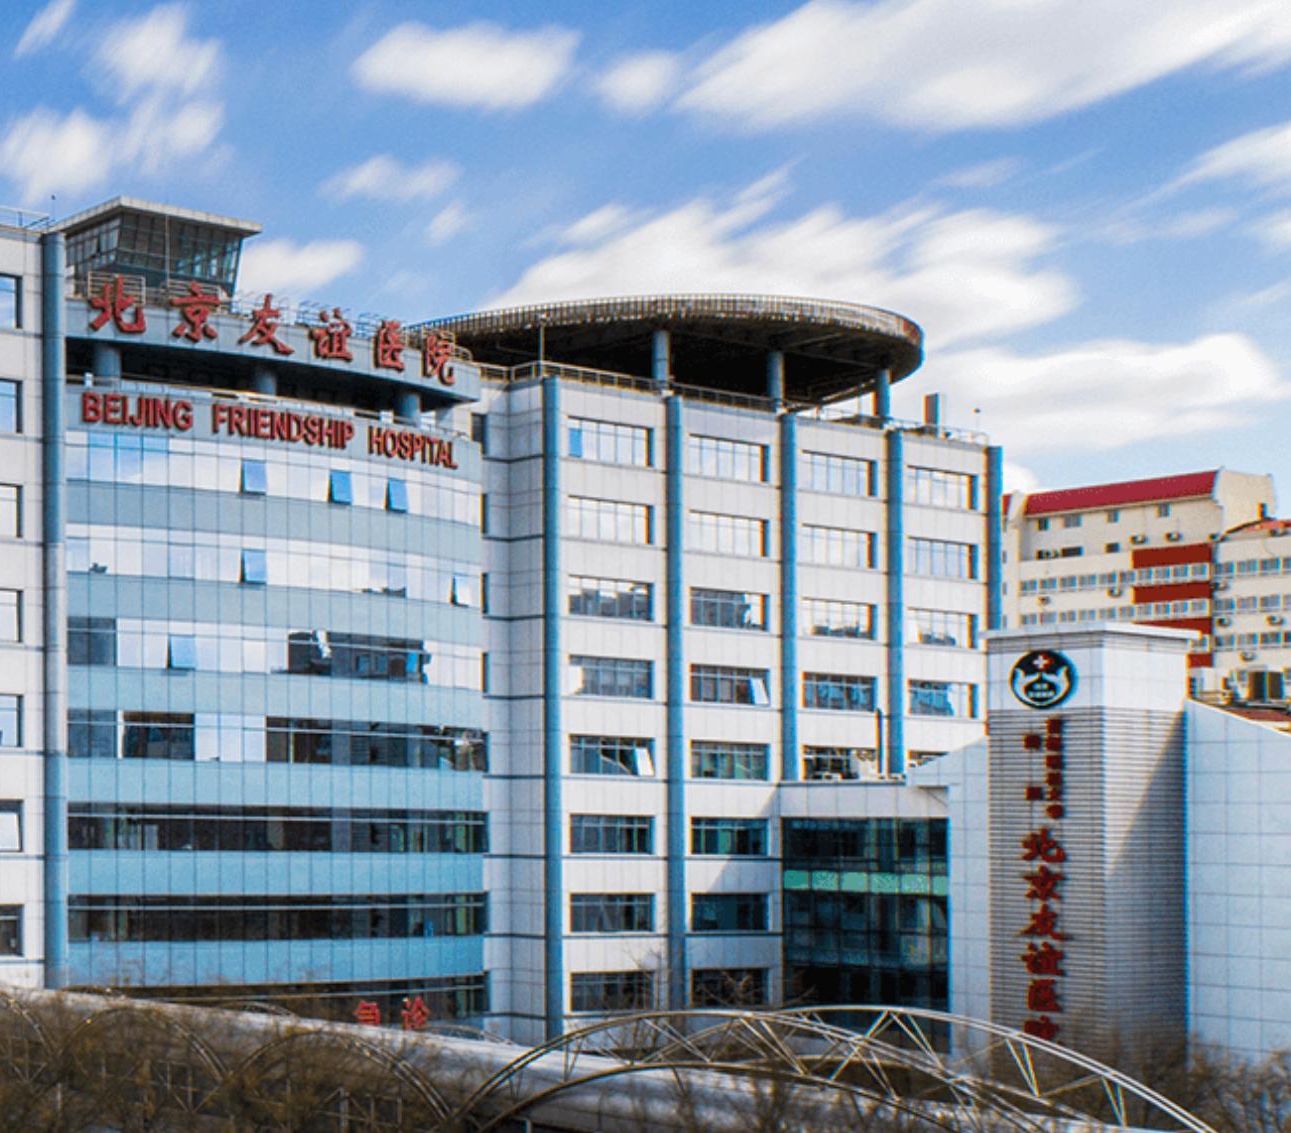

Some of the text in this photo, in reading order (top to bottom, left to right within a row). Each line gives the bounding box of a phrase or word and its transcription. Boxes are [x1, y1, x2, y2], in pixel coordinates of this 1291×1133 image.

[89, 274, 457, 385] 北京友谊医院
[81, 391, 458, 470] BEIJING FRIENDSHIP HOSPITAL
